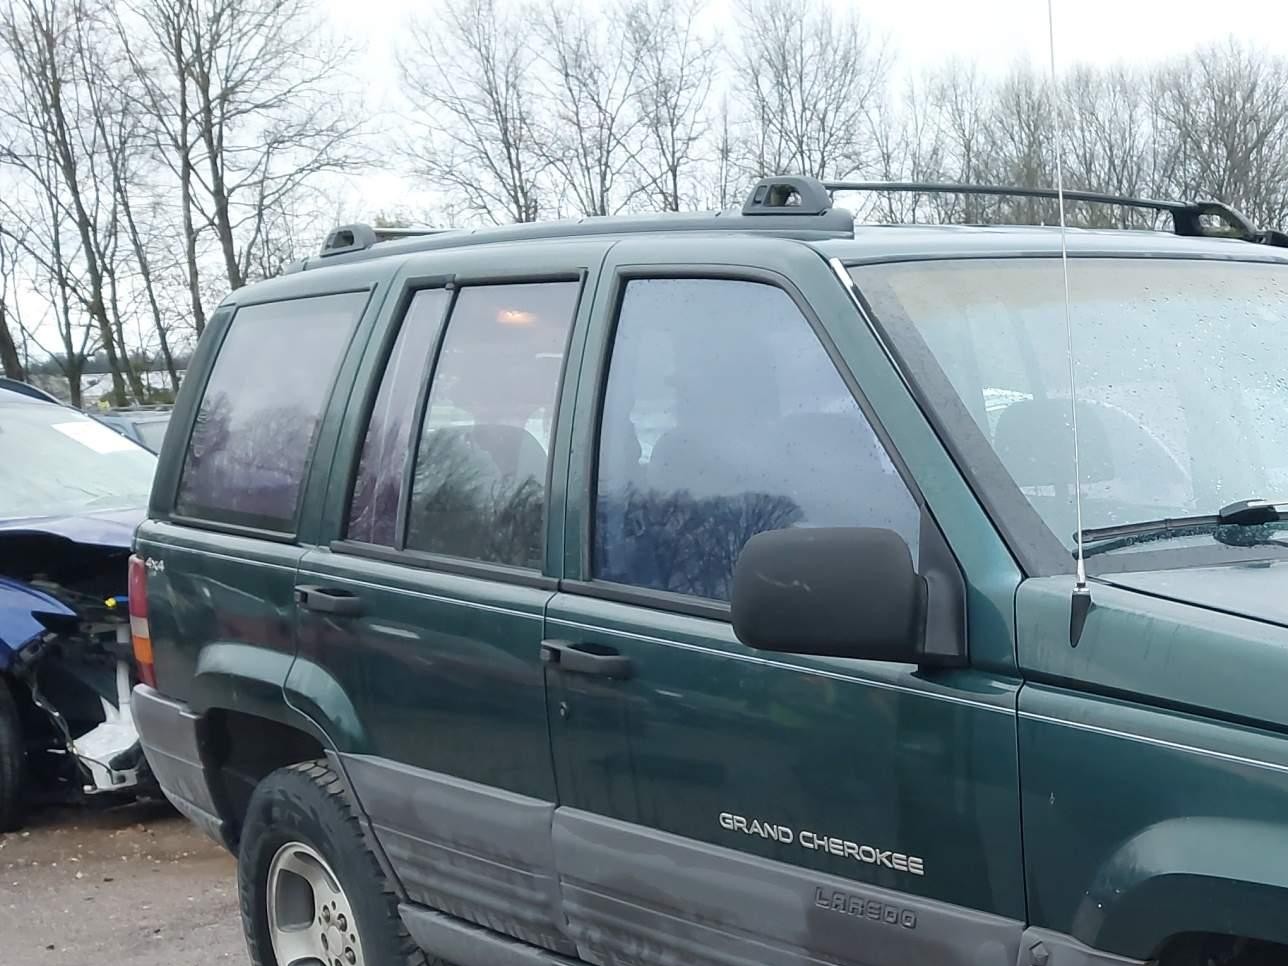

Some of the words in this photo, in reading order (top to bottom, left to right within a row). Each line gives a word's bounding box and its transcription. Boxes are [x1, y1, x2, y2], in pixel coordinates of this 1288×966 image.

[718, 811, 794, 844] GRAND
[799, 830, 925, 876] CHEROKEE
[815, 886, 918, 929] LAREDO
